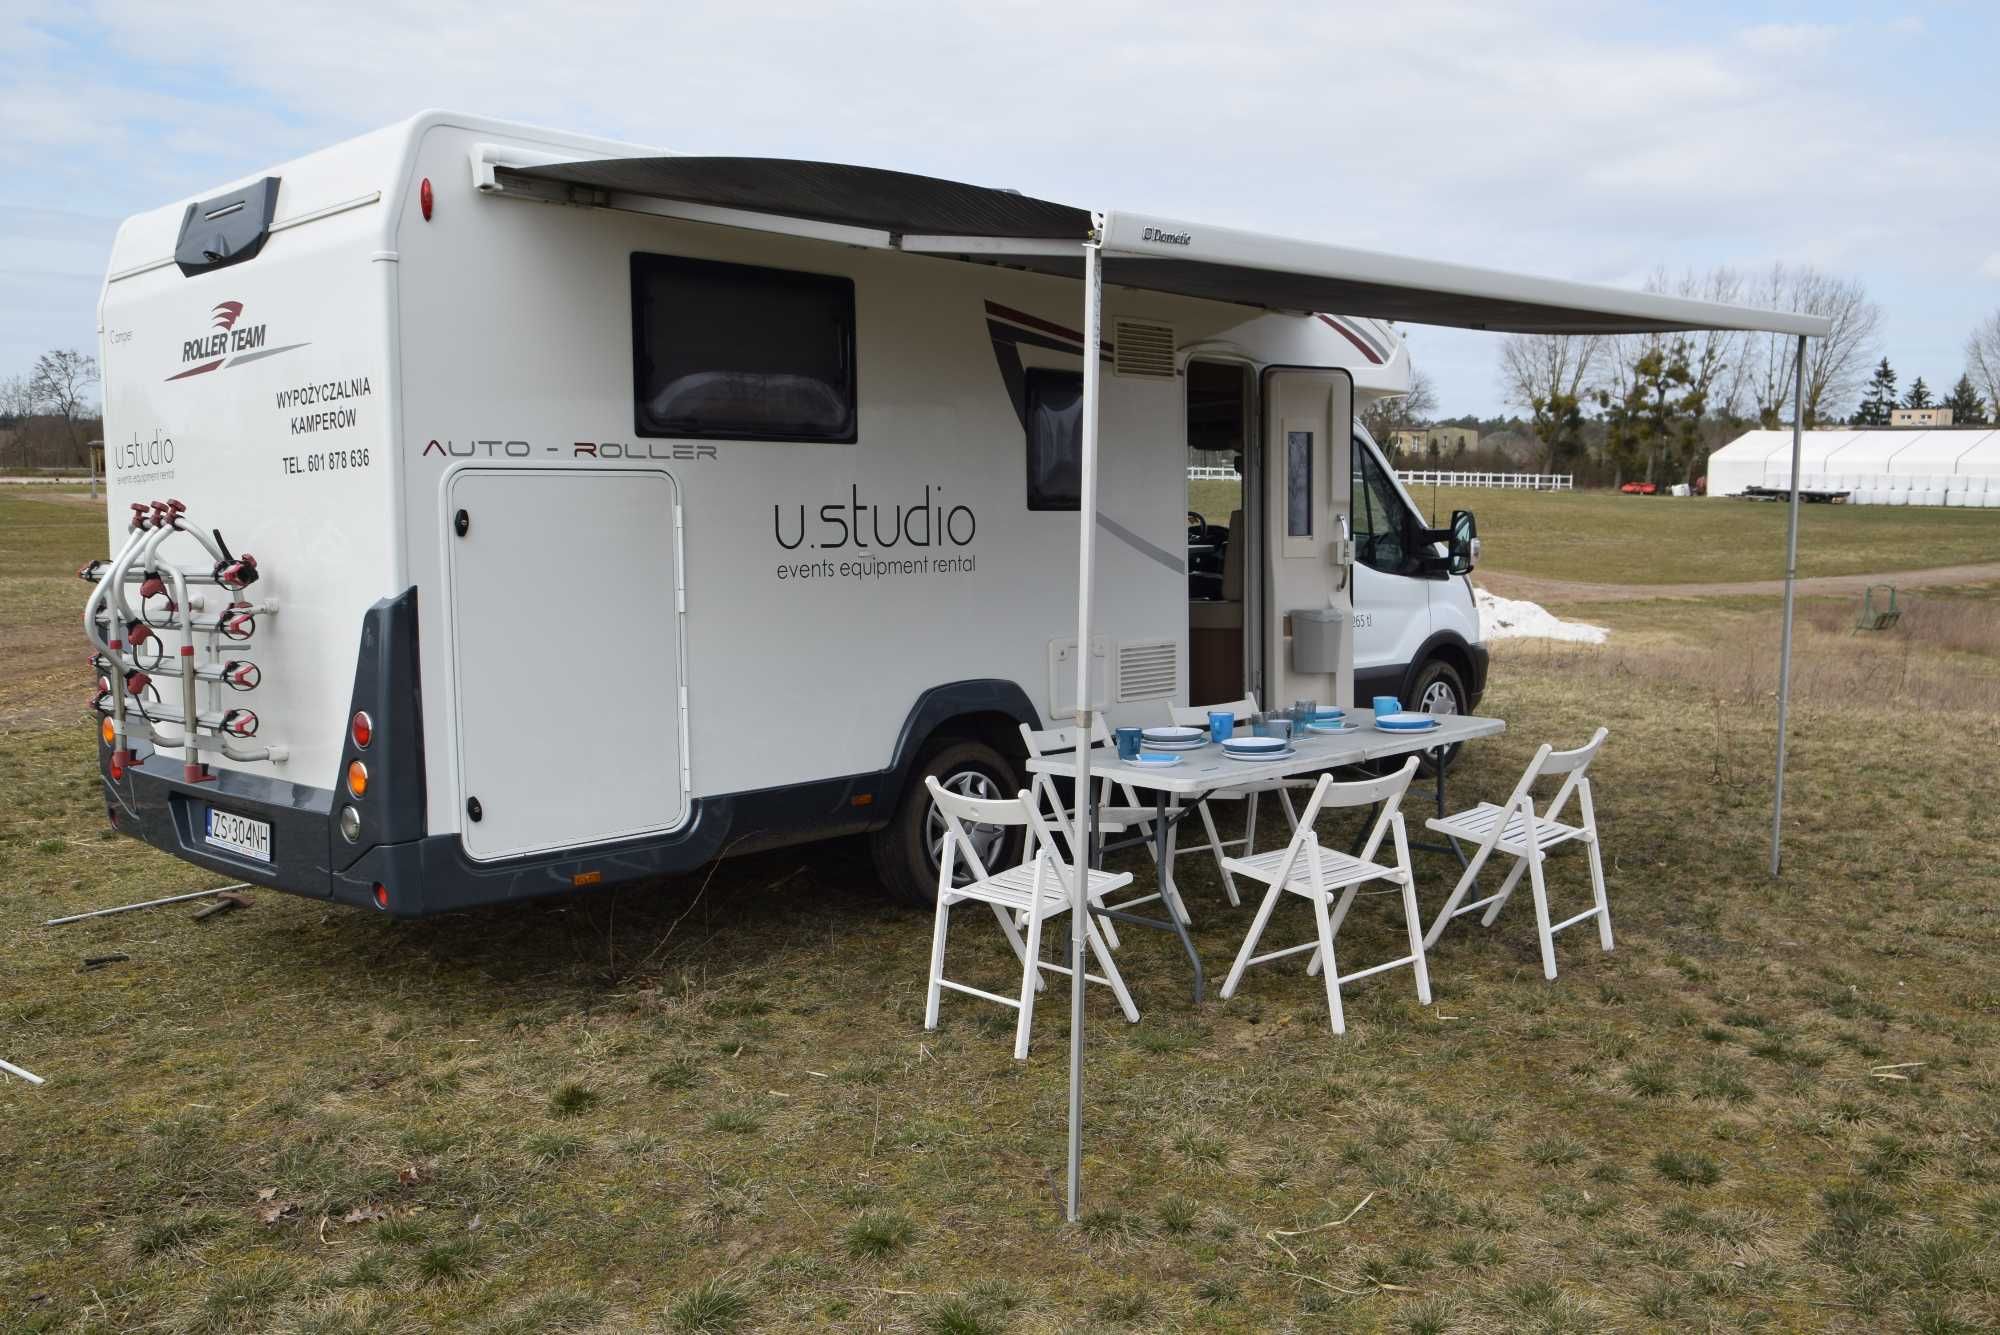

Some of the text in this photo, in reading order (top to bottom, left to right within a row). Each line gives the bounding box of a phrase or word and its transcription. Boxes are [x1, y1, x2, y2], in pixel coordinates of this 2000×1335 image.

[1154, 228, 1192, 245] Dometic
[182, 324, 266, 361] ROLLER TEAM
[276, 377, 371, 409] WYPOŻYCZALNIA
[291, 406, 356, 435] KAMPERÓW
[282, 448, 369, 474] TEL. 601 878 636
[423, 440, 530, 457] AUTO
[574, 442, 717, 460] ROLLER
[775, 484, 975, 549] u.studio
[777, 555, 976, 580] events equipment rental
